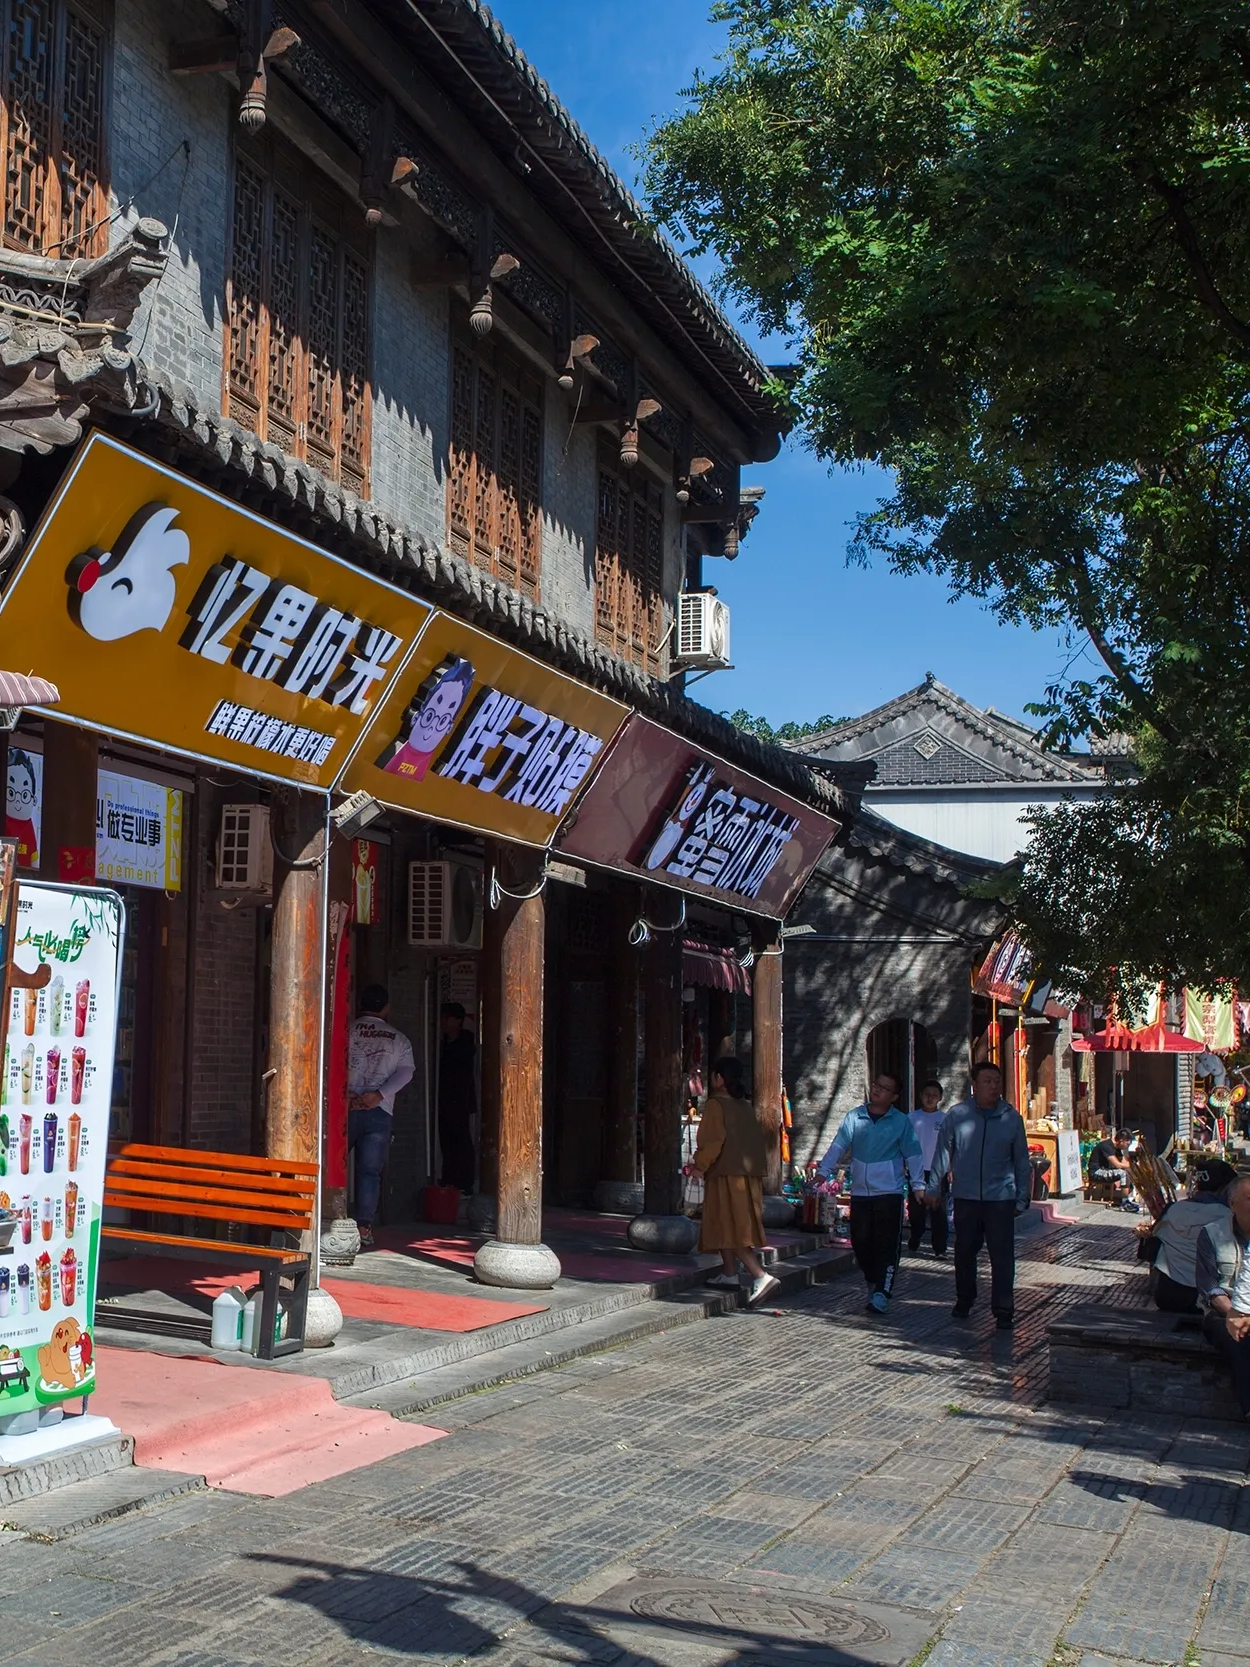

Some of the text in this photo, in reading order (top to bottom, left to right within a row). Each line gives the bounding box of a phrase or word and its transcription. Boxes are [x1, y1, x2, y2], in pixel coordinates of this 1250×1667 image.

[187, 558, 403, 716] 忆果时光
[397, 762, 418, 776] PZTM
[107, 808, 161, 847] 做专业事
[115, 803, 144, 816] professional
[666, 785, 801, 900] 蜜雪冰城
